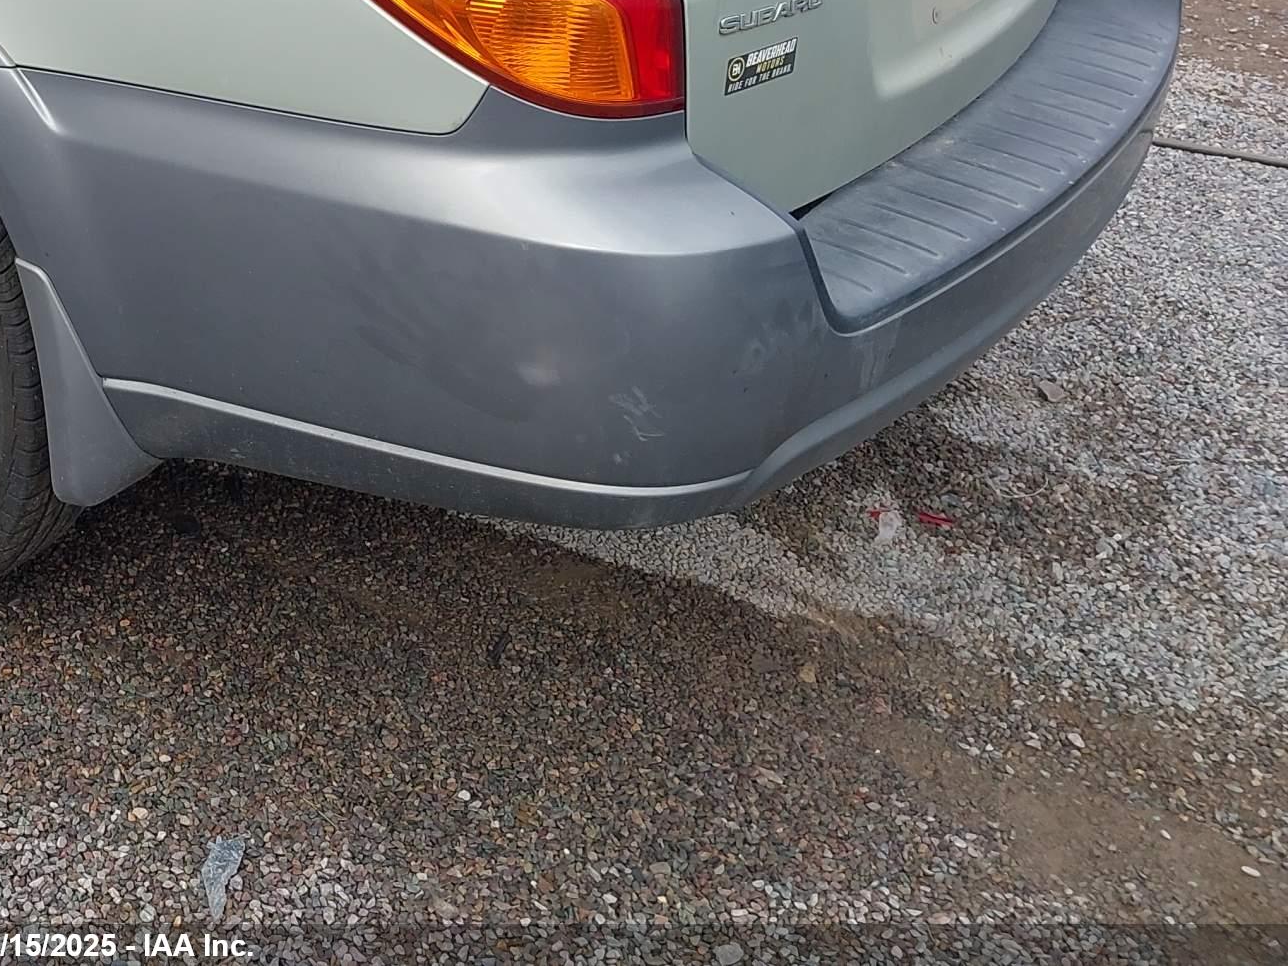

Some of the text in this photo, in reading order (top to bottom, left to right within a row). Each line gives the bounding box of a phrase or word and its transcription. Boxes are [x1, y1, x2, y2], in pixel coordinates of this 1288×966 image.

[746, 38, 797, 67] BEAVERHEAD
[756, 55, 786, 74] MOTORS
[727, 80, 744, 93] RIDE
[744, 75, 758, 87] FOR
[759, 71, 771, 82] THE
